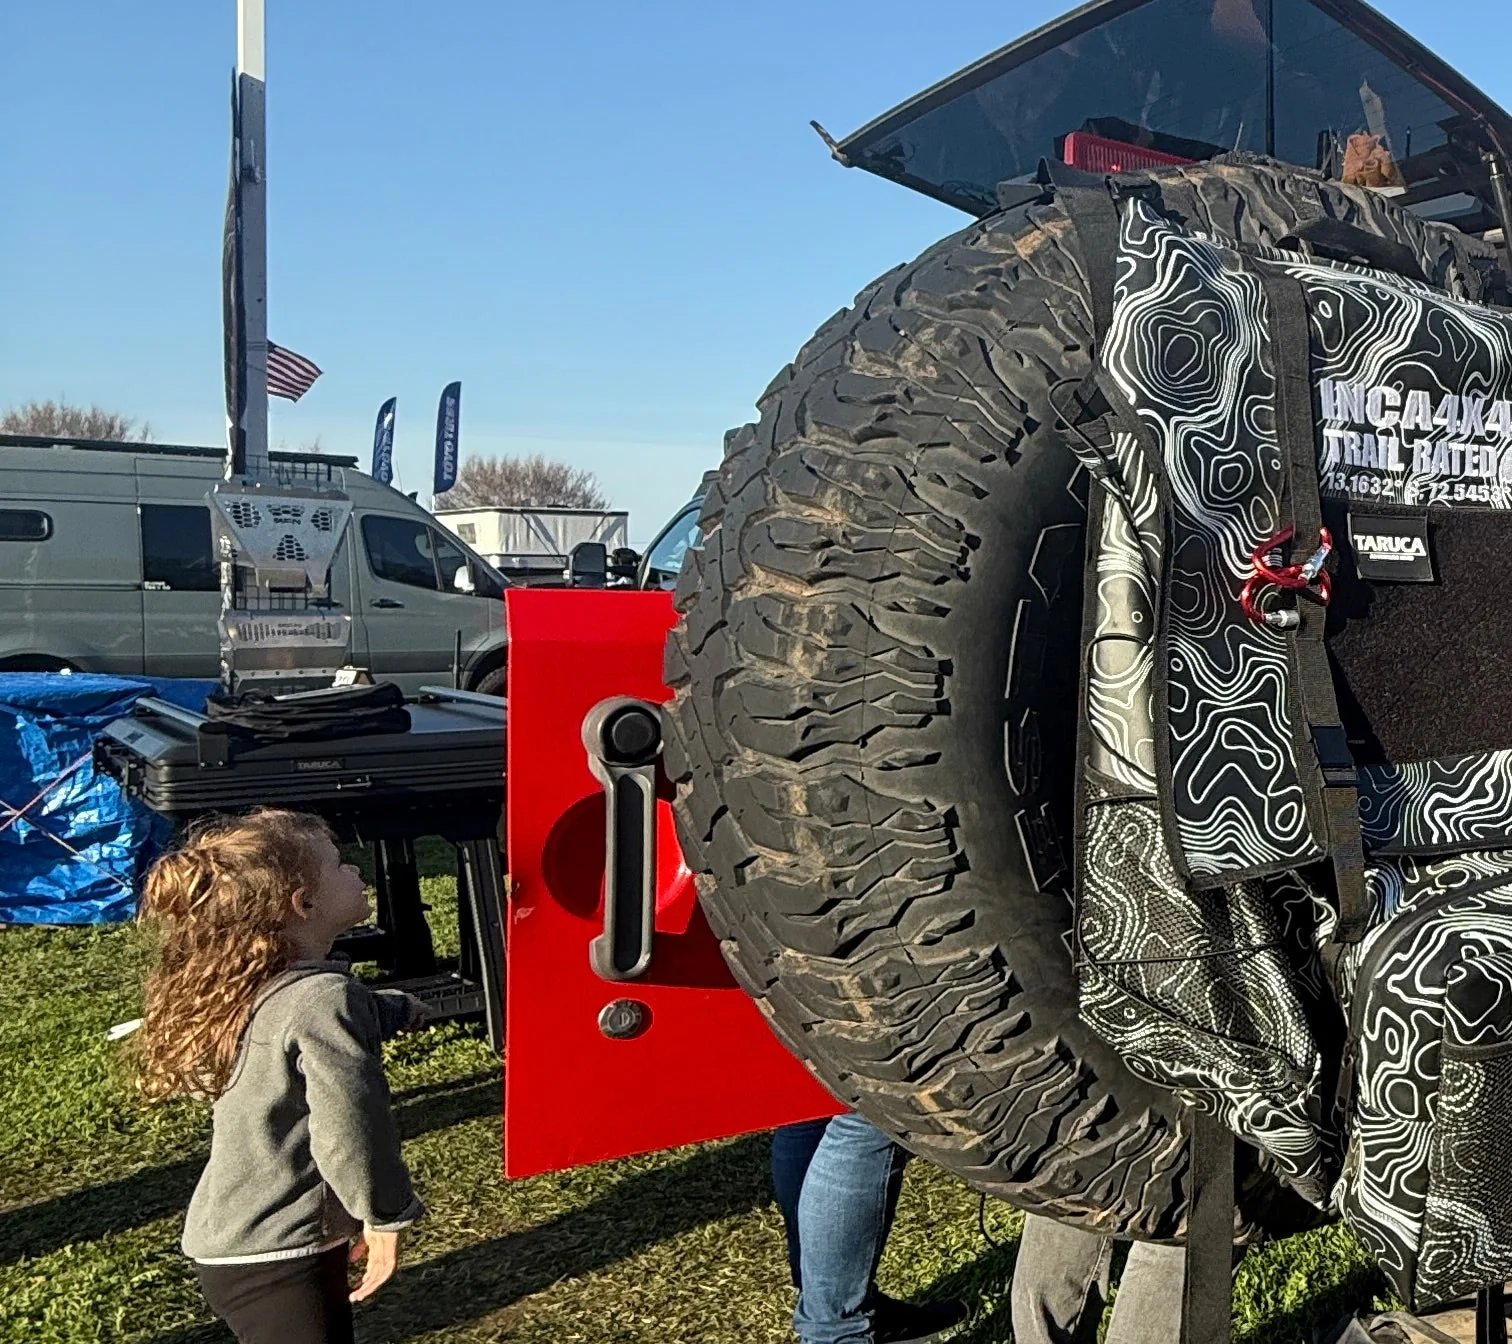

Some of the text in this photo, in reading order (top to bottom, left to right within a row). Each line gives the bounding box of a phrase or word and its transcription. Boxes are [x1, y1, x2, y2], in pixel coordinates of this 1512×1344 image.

[443, 396, 456, 481] TOYO TIRES
[1323, 428, 1498, 478] TRAIL RATED
[1353, 534, 1427, 557] TARUCA
